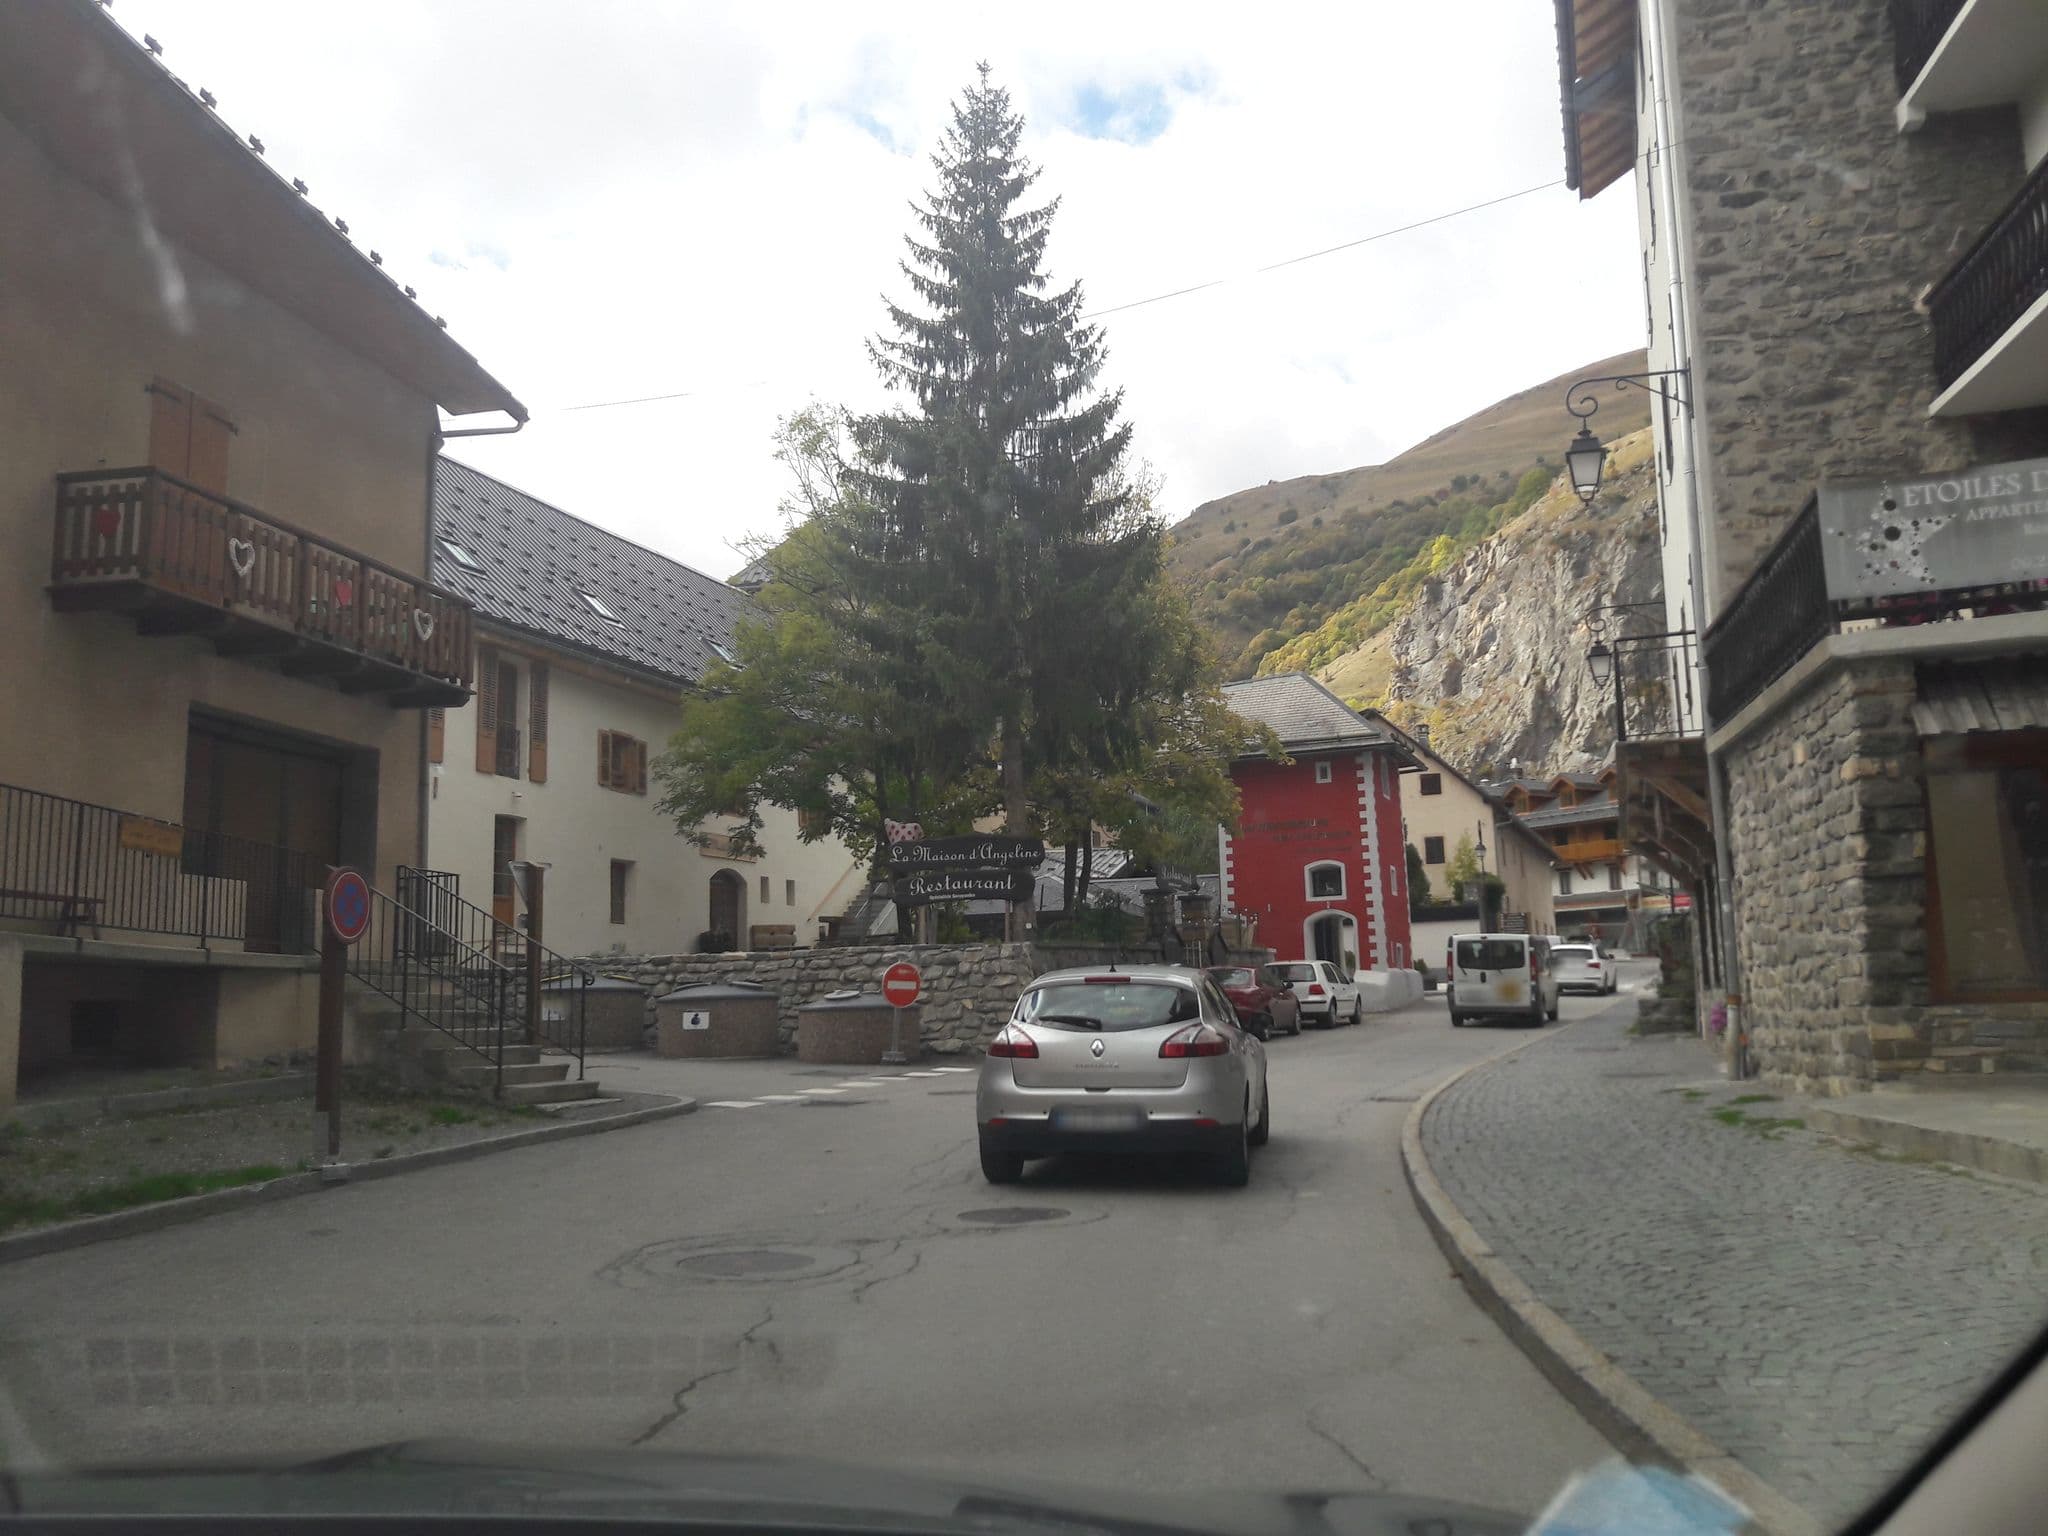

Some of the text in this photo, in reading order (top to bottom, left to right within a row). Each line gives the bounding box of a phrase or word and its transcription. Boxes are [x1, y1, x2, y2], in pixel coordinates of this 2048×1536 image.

[1903, 472, 2021, 507] ETOILES
[1966, 500, 2048, 521] APPARTE
[889, 842, 1042, 866] La Maison d'Angeline
[910, 874, 1016, 897] Restaurant
